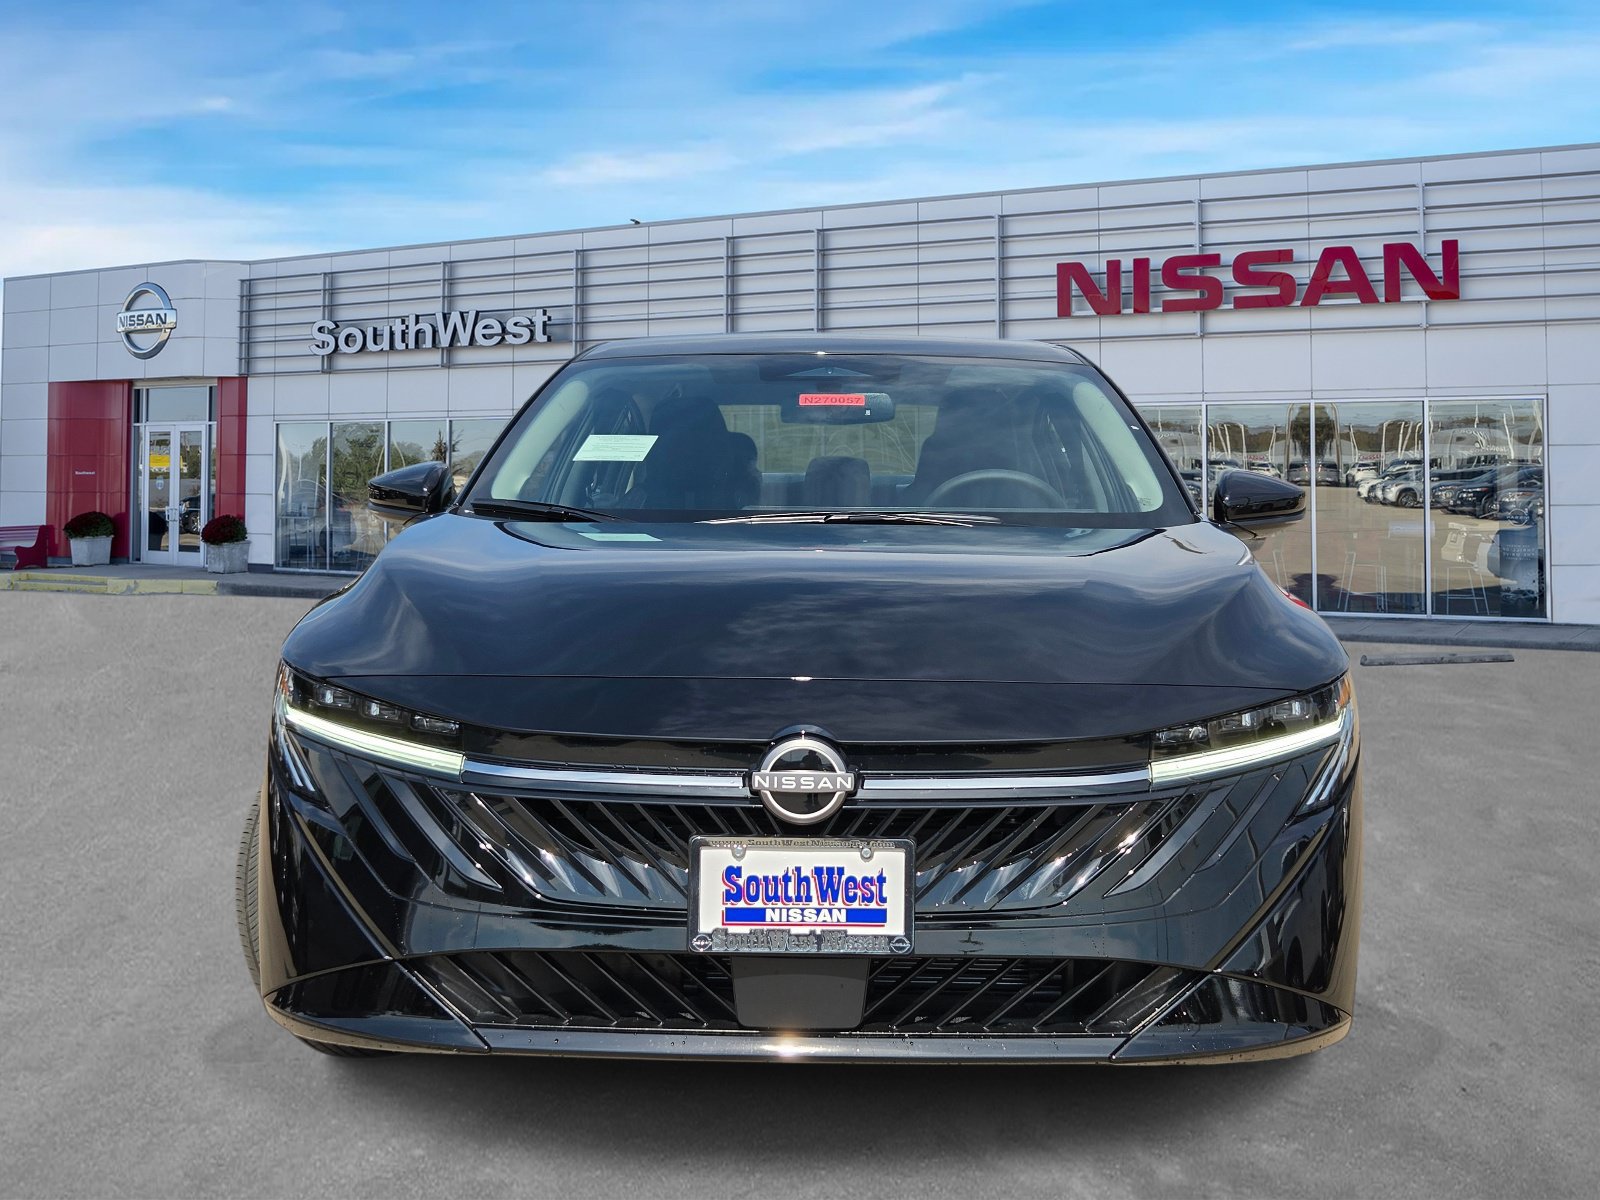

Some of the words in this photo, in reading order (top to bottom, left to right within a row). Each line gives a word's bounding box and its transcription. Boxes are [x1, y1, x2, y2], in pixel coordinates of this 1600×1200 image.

[1056, 239, 1461, 318] NISSAN
[118, 312, 168, 328] NISSAN
[309, 309, 550, 356] SouthWest
[803, 396, 862, 404] N270057
[754, 775, 852, 789] NISSAN
[722, 864, 888, 906] SouthWest
[765, 908, 847, 923] NISSAN
[711, 928, 818, 951] SouthWest
